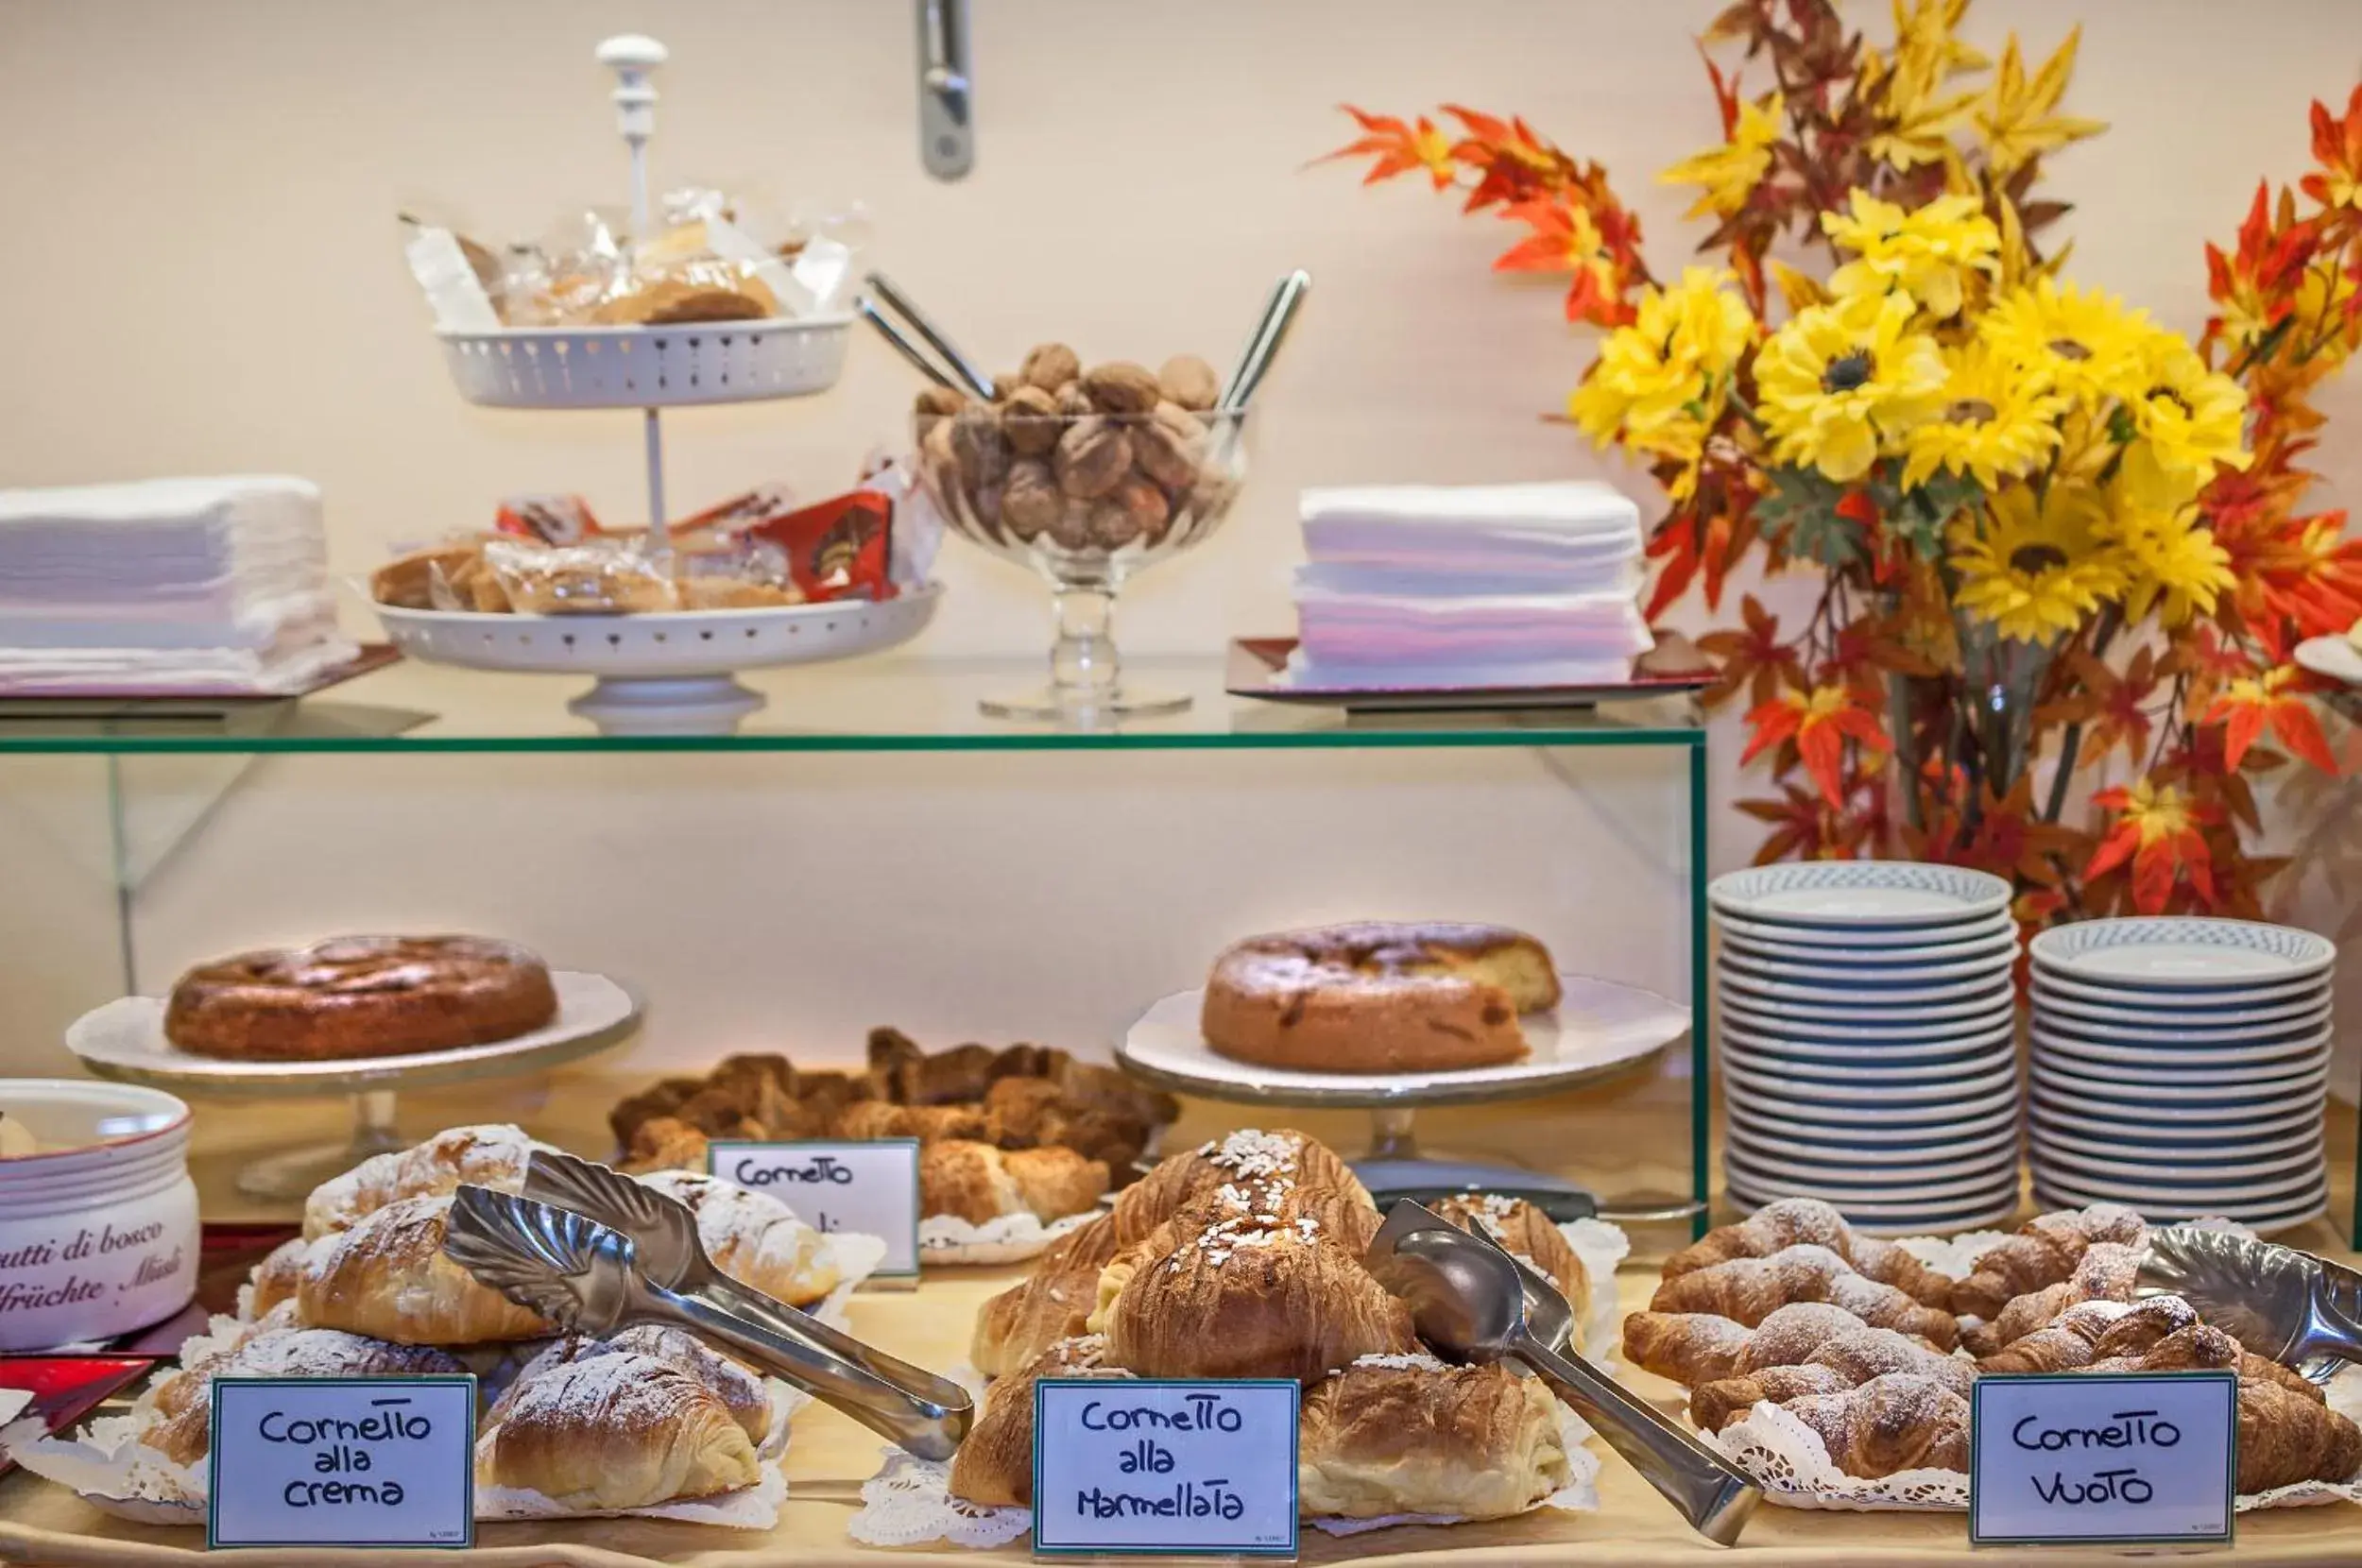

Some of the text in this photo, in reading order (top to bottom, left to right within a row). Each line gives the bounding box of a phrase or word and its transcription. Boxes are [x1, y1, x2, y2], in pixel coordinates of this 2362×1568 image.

[736, 1157, 853, 1185] Cornetto
[62, 1229, 94, 1262] di
[100, 1224, 163, 1254] bosco
[0, 1275, 104, 1313] früchte
[259, 1398, 431, 1444] Cornetto
[1082, 1393, 1241, 1432] Cornetto
[2012, 1410, 2181, 1451] Cornetto
[315, 1445, 371, 1473] alla
[1119, 1440, 1175, 1474] alla
[1077, 1478, 1244, 1520] Marmellata
